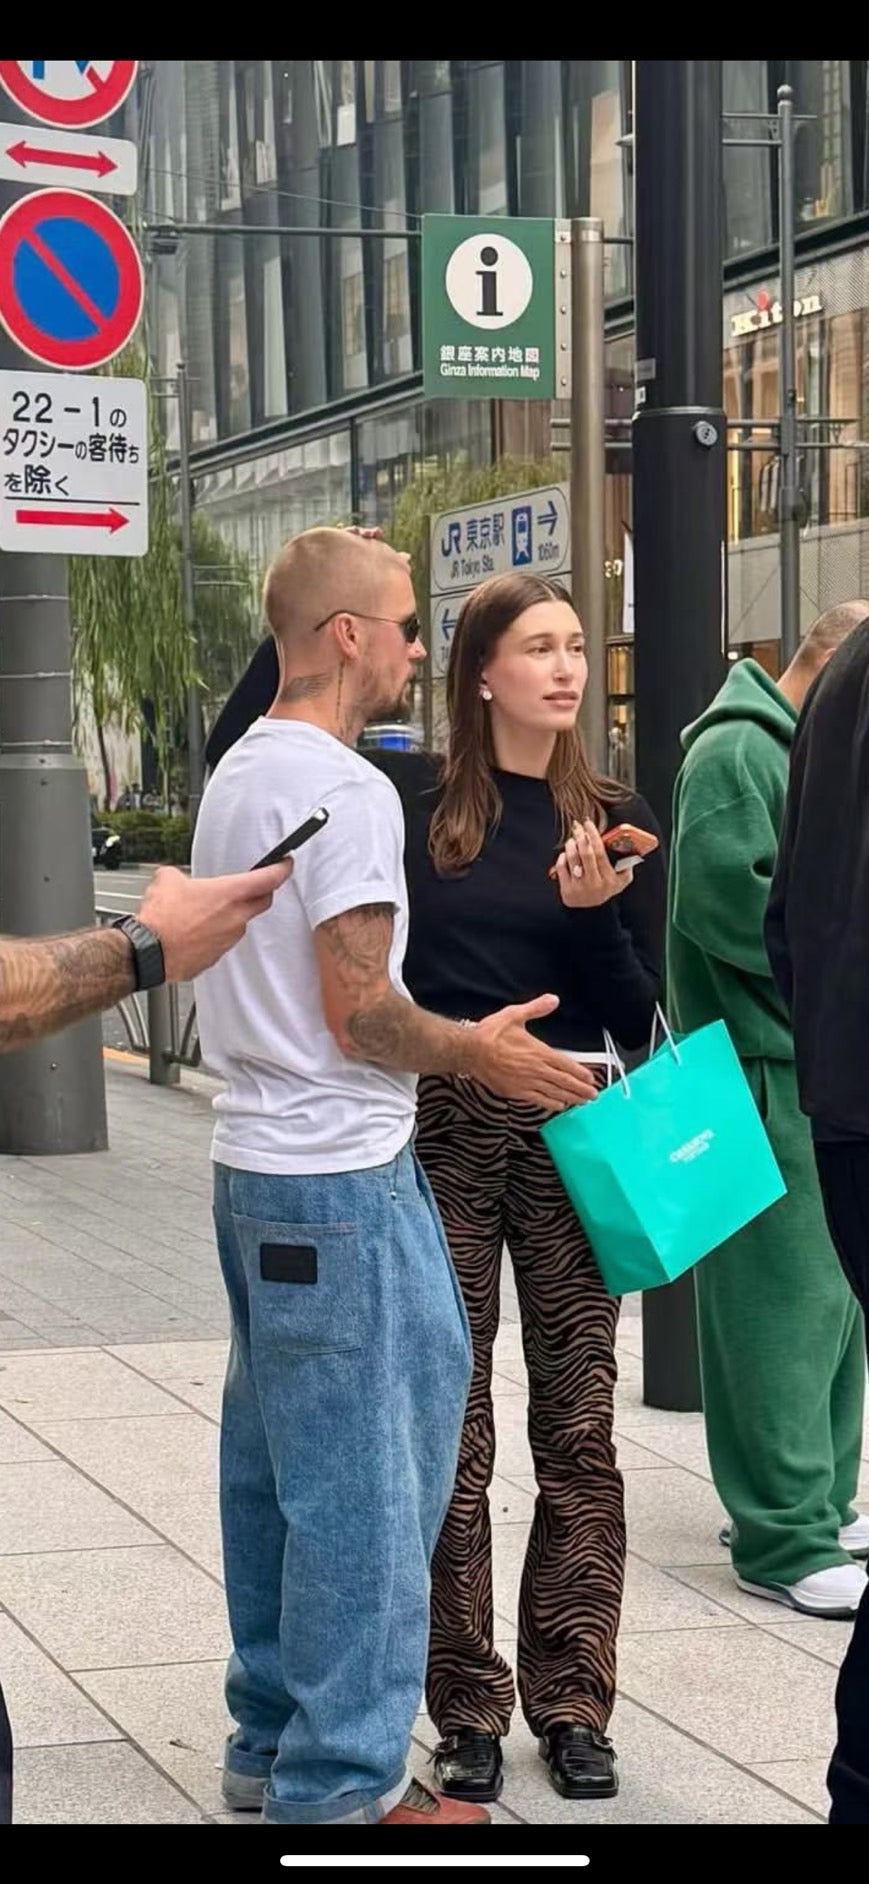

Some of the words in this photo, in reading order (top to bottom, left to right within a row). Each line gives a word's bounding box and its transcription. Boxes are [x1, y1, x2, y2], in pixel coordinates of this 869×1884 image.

[440, 345, 539, 363] 銀座案内地図
[440, 363, 466, 376] Ginza
[468, 363, 519, 377] Information
[520, 364, 540, 381] Map
[3, 428, 139, 464] タクシーの客待ち
[4, 464, 69, 496] を除く
[441, 522, 461, 557] JR
[466, 513, 505, 551] 東京駅
